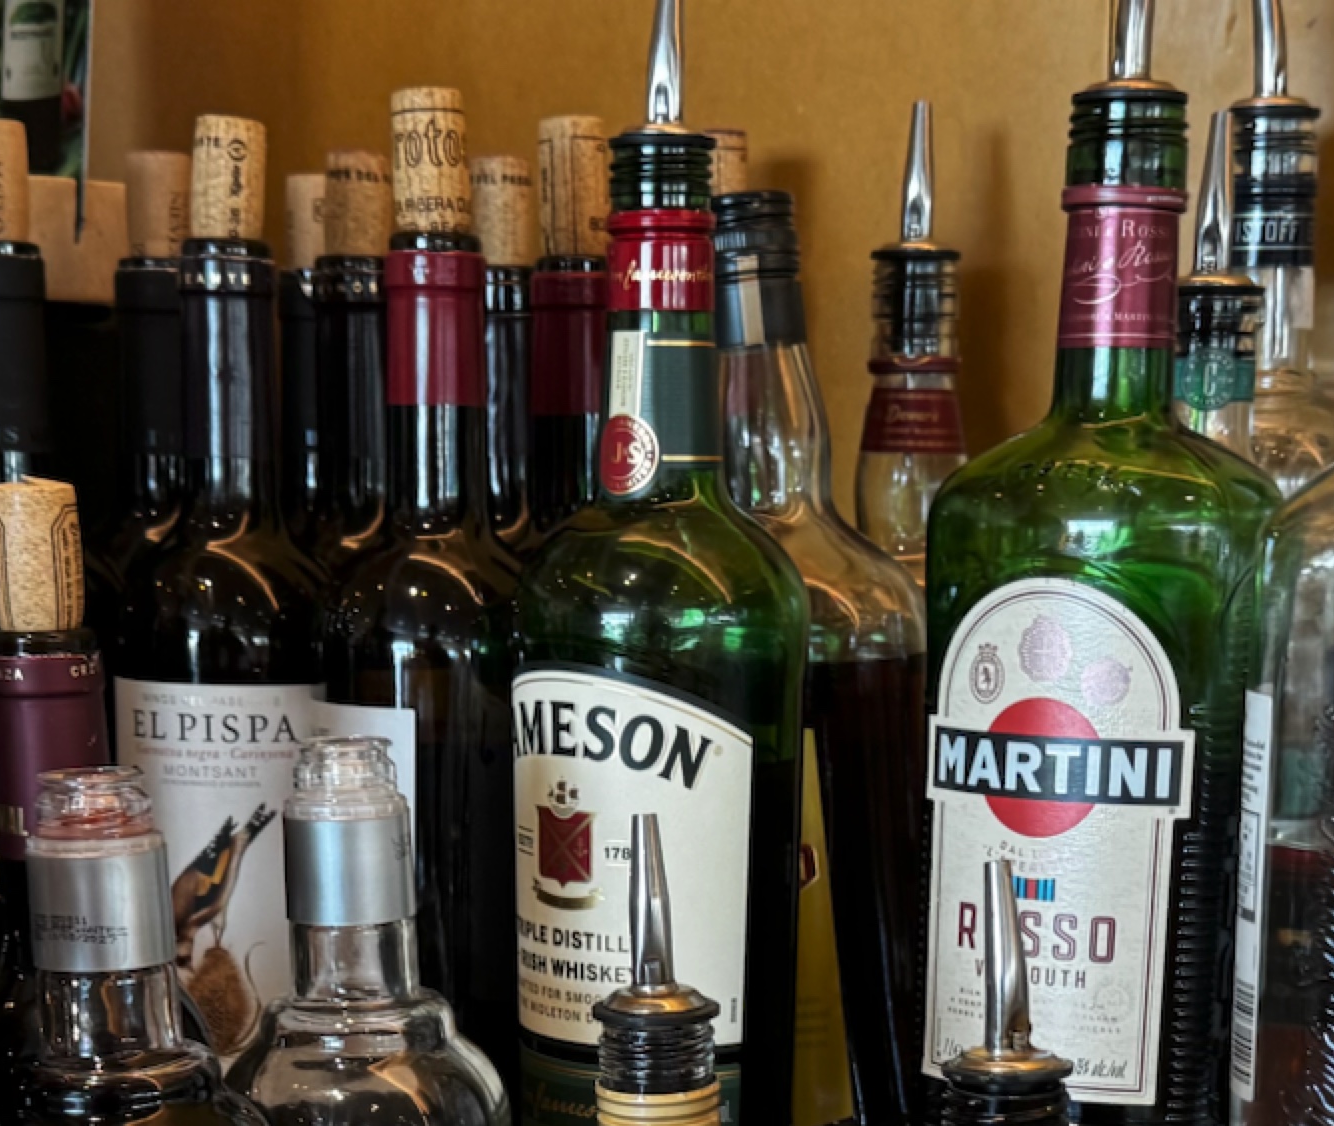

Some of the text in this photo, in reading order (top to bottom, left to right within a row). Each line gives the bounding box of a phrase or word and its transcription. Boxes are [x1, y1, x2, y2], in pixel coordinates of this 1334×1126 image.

[133, 708, 301, 744] EL PISPA
[936, 733, 1176, 801] MARTINI
[958, 902, 1116, 964] RSSO
[975, 959, 1086, 989] VOUTH
